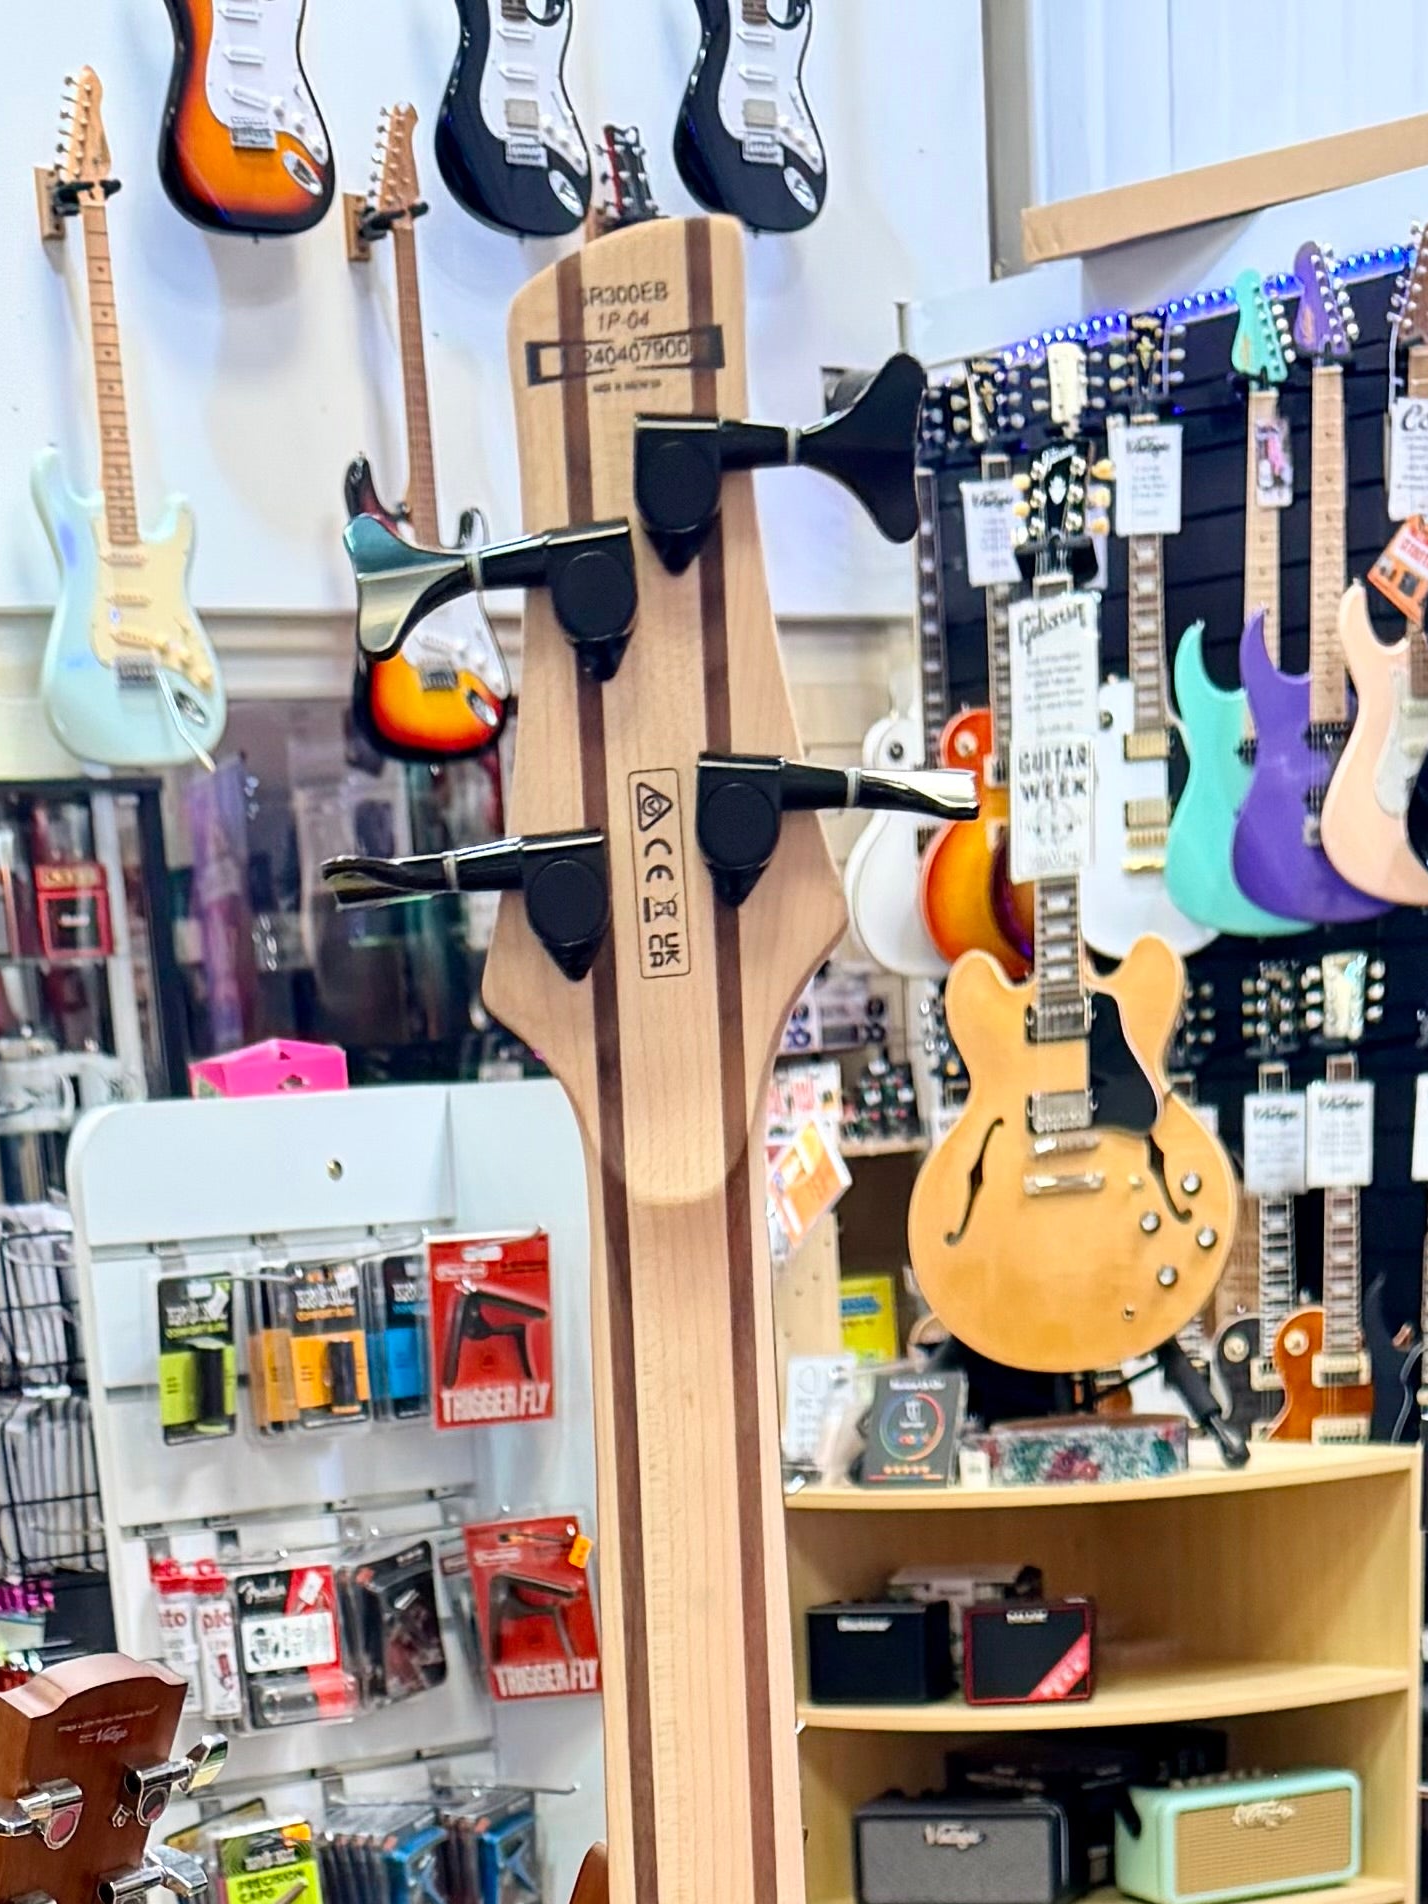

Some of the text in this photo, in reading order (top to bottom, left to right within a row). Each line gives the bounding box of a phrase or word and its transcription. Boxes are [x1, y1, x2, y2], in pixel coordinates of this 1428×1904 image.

[441, 1382, 550, 1423] TRIGGER FLY
[495, 1657, 601, 1698] TRIGGER FLY
[238, 1888, 277, 1904] CAPO
